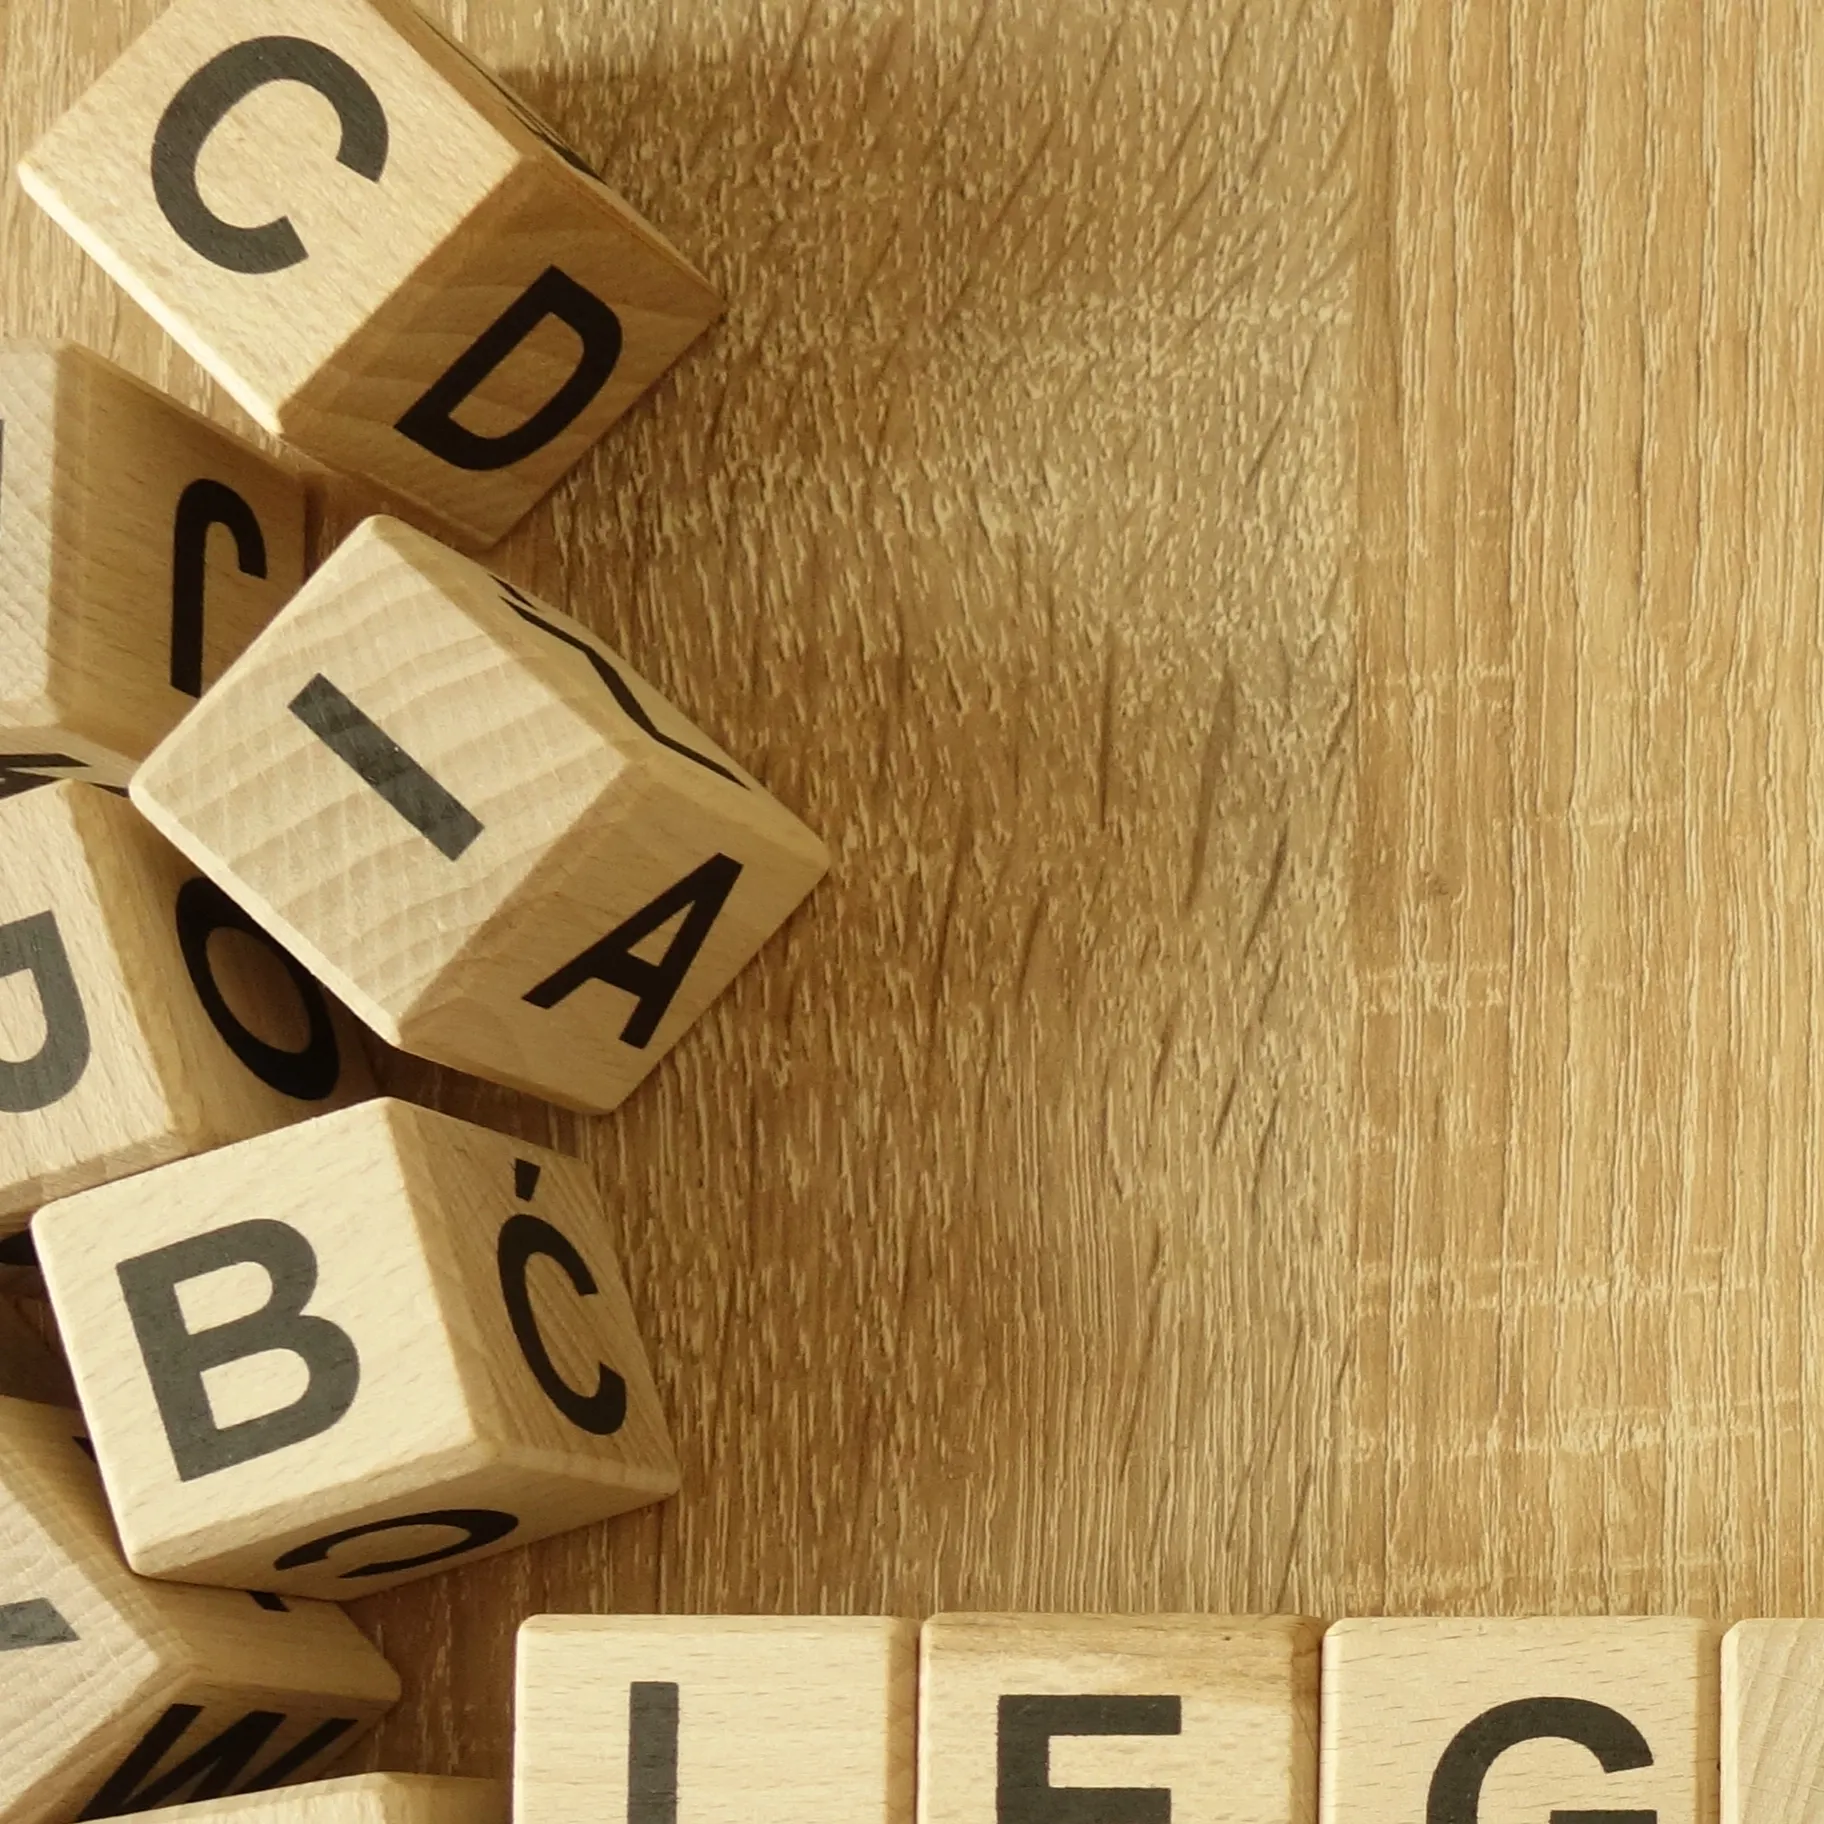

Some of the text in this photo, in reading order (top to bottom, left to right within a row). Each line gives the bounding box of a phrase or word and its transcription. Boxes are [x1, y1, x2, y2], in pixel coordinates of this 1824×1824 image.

[150, 35, 388, 274] C
[392, 264, 623, 472] D
[288, 673, 485, 862] I
[521, 852, 744, 1050] A
[116, 1218, 361, 1482] B
